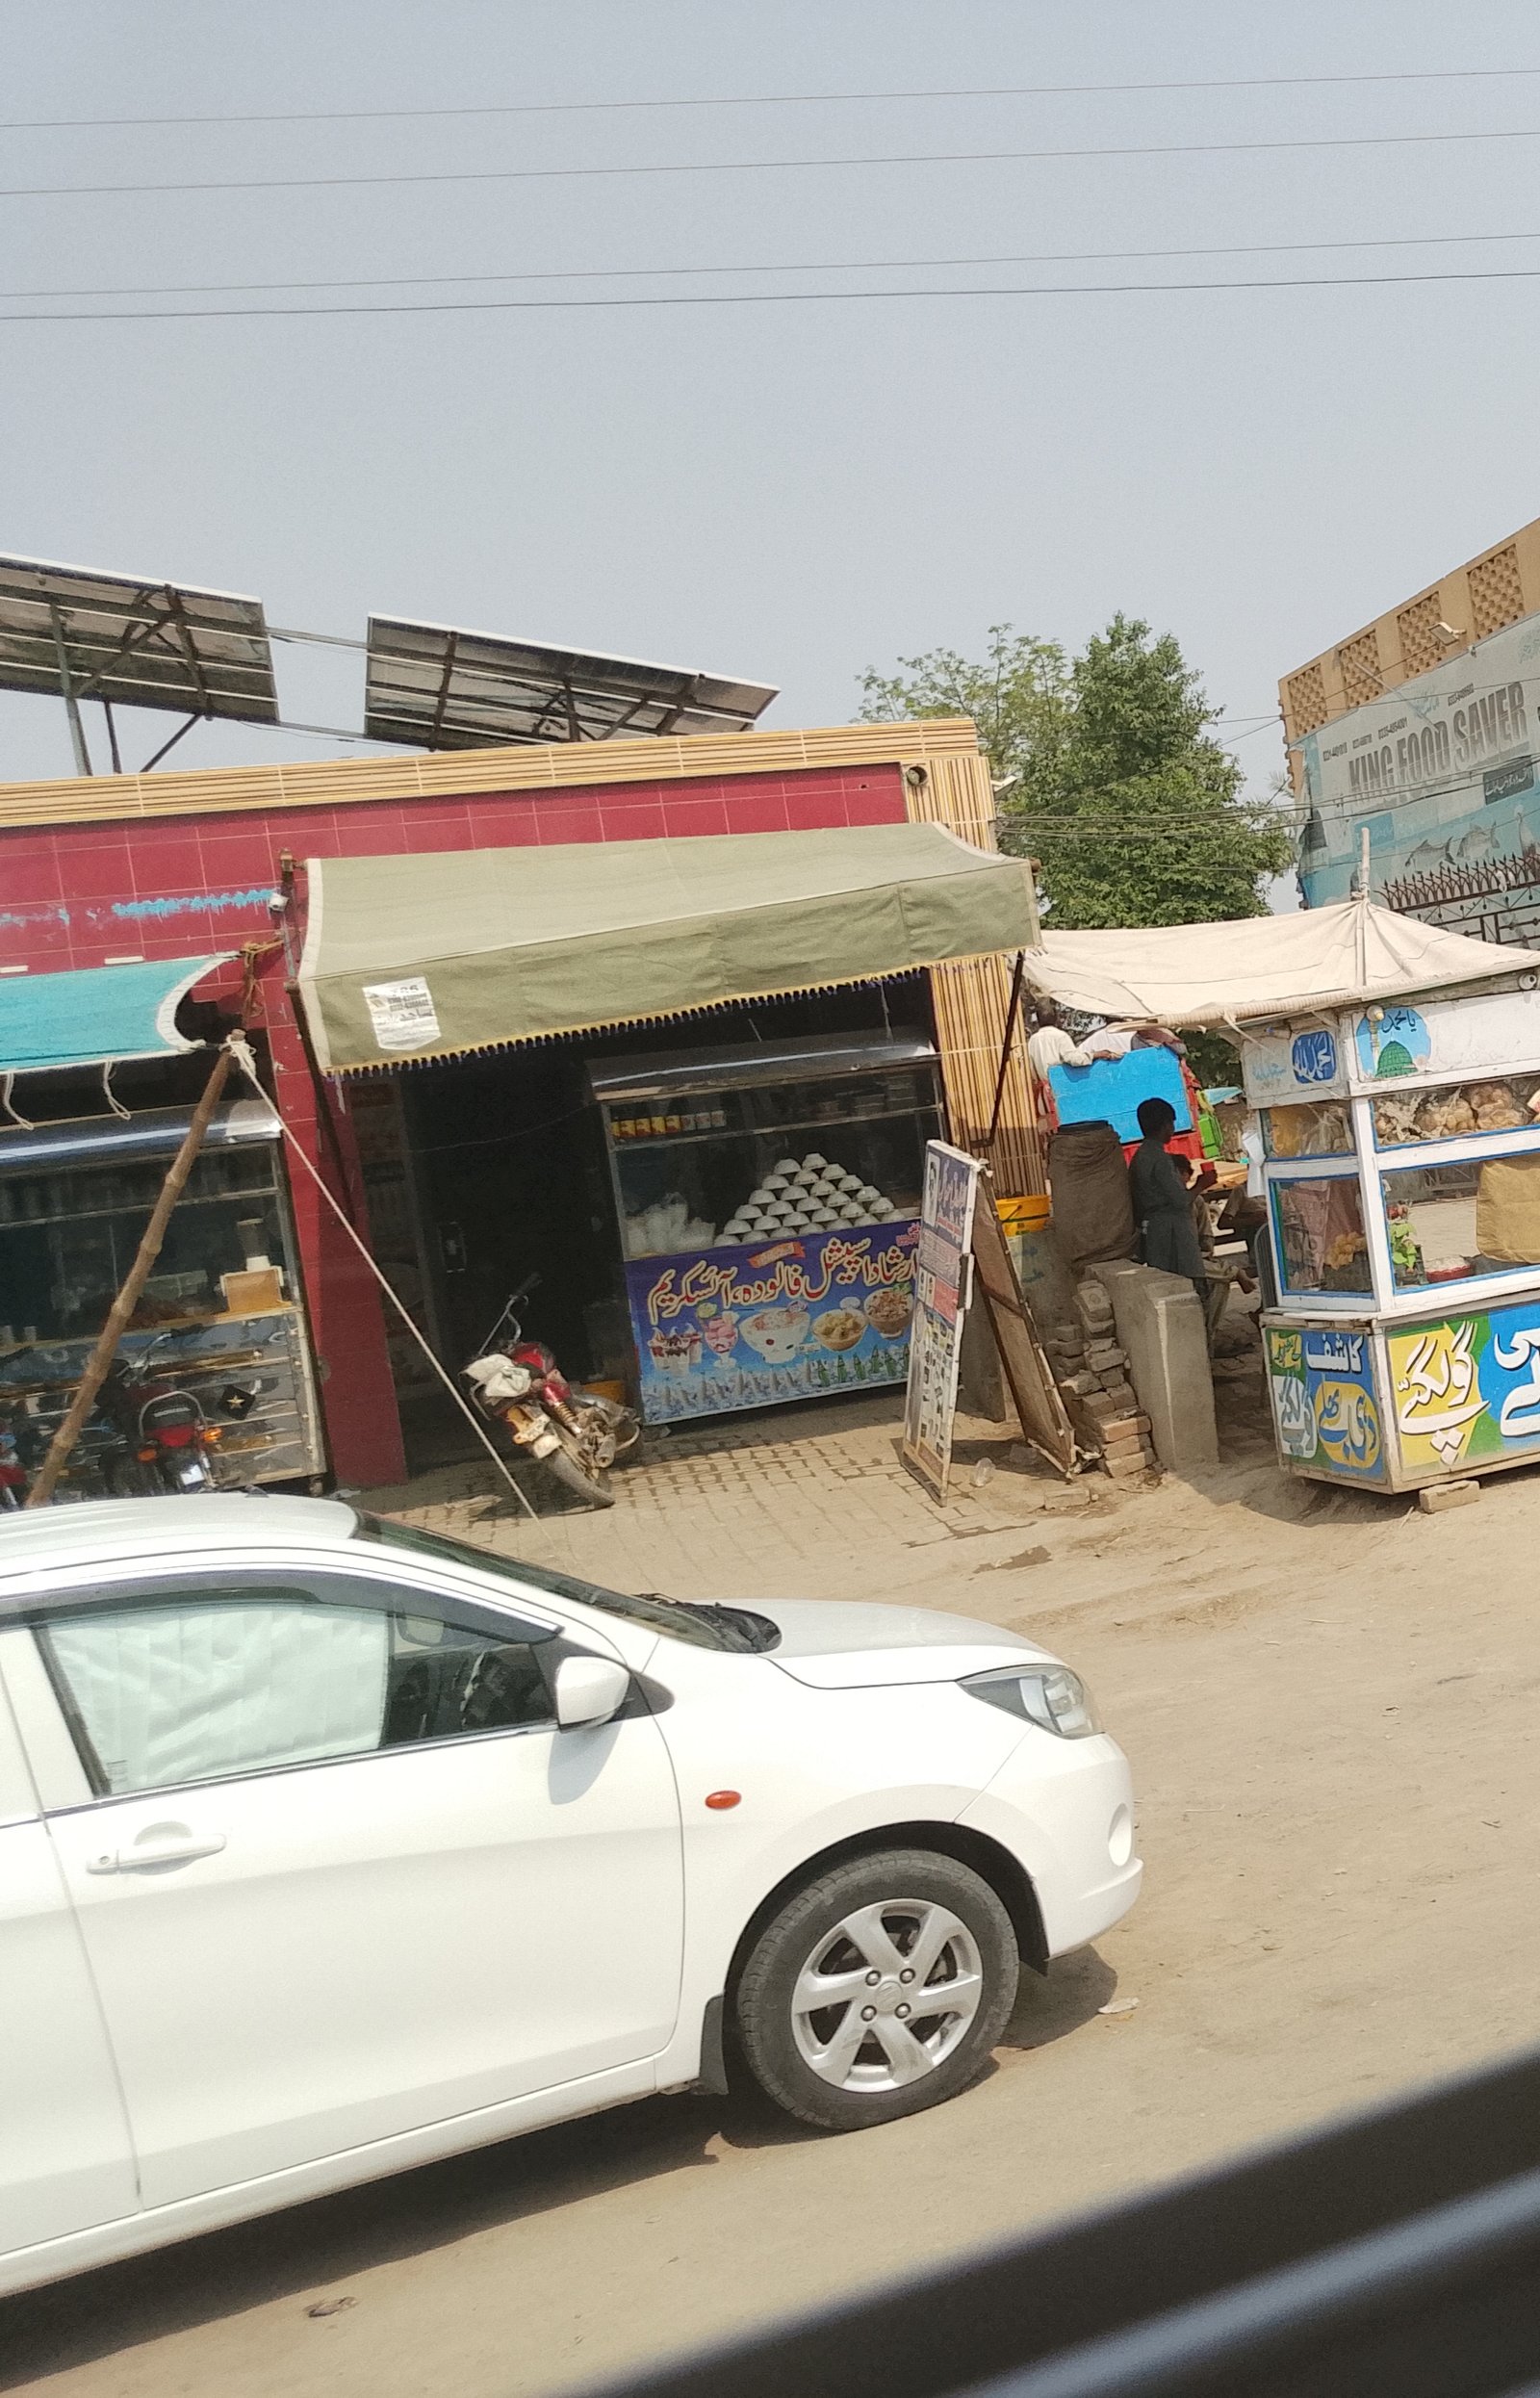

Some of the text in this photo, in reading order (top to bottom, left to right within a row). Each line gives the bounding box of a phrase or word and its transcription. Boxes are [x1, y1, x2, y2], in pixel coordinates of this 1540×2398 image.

[1348, 745, 1395, 797] KING
[1397, 720, 1450, 785] FOOD
[1453, 682, 1527, 768] SAVER
[1306, 1333, 1365, 1374] کاشف
